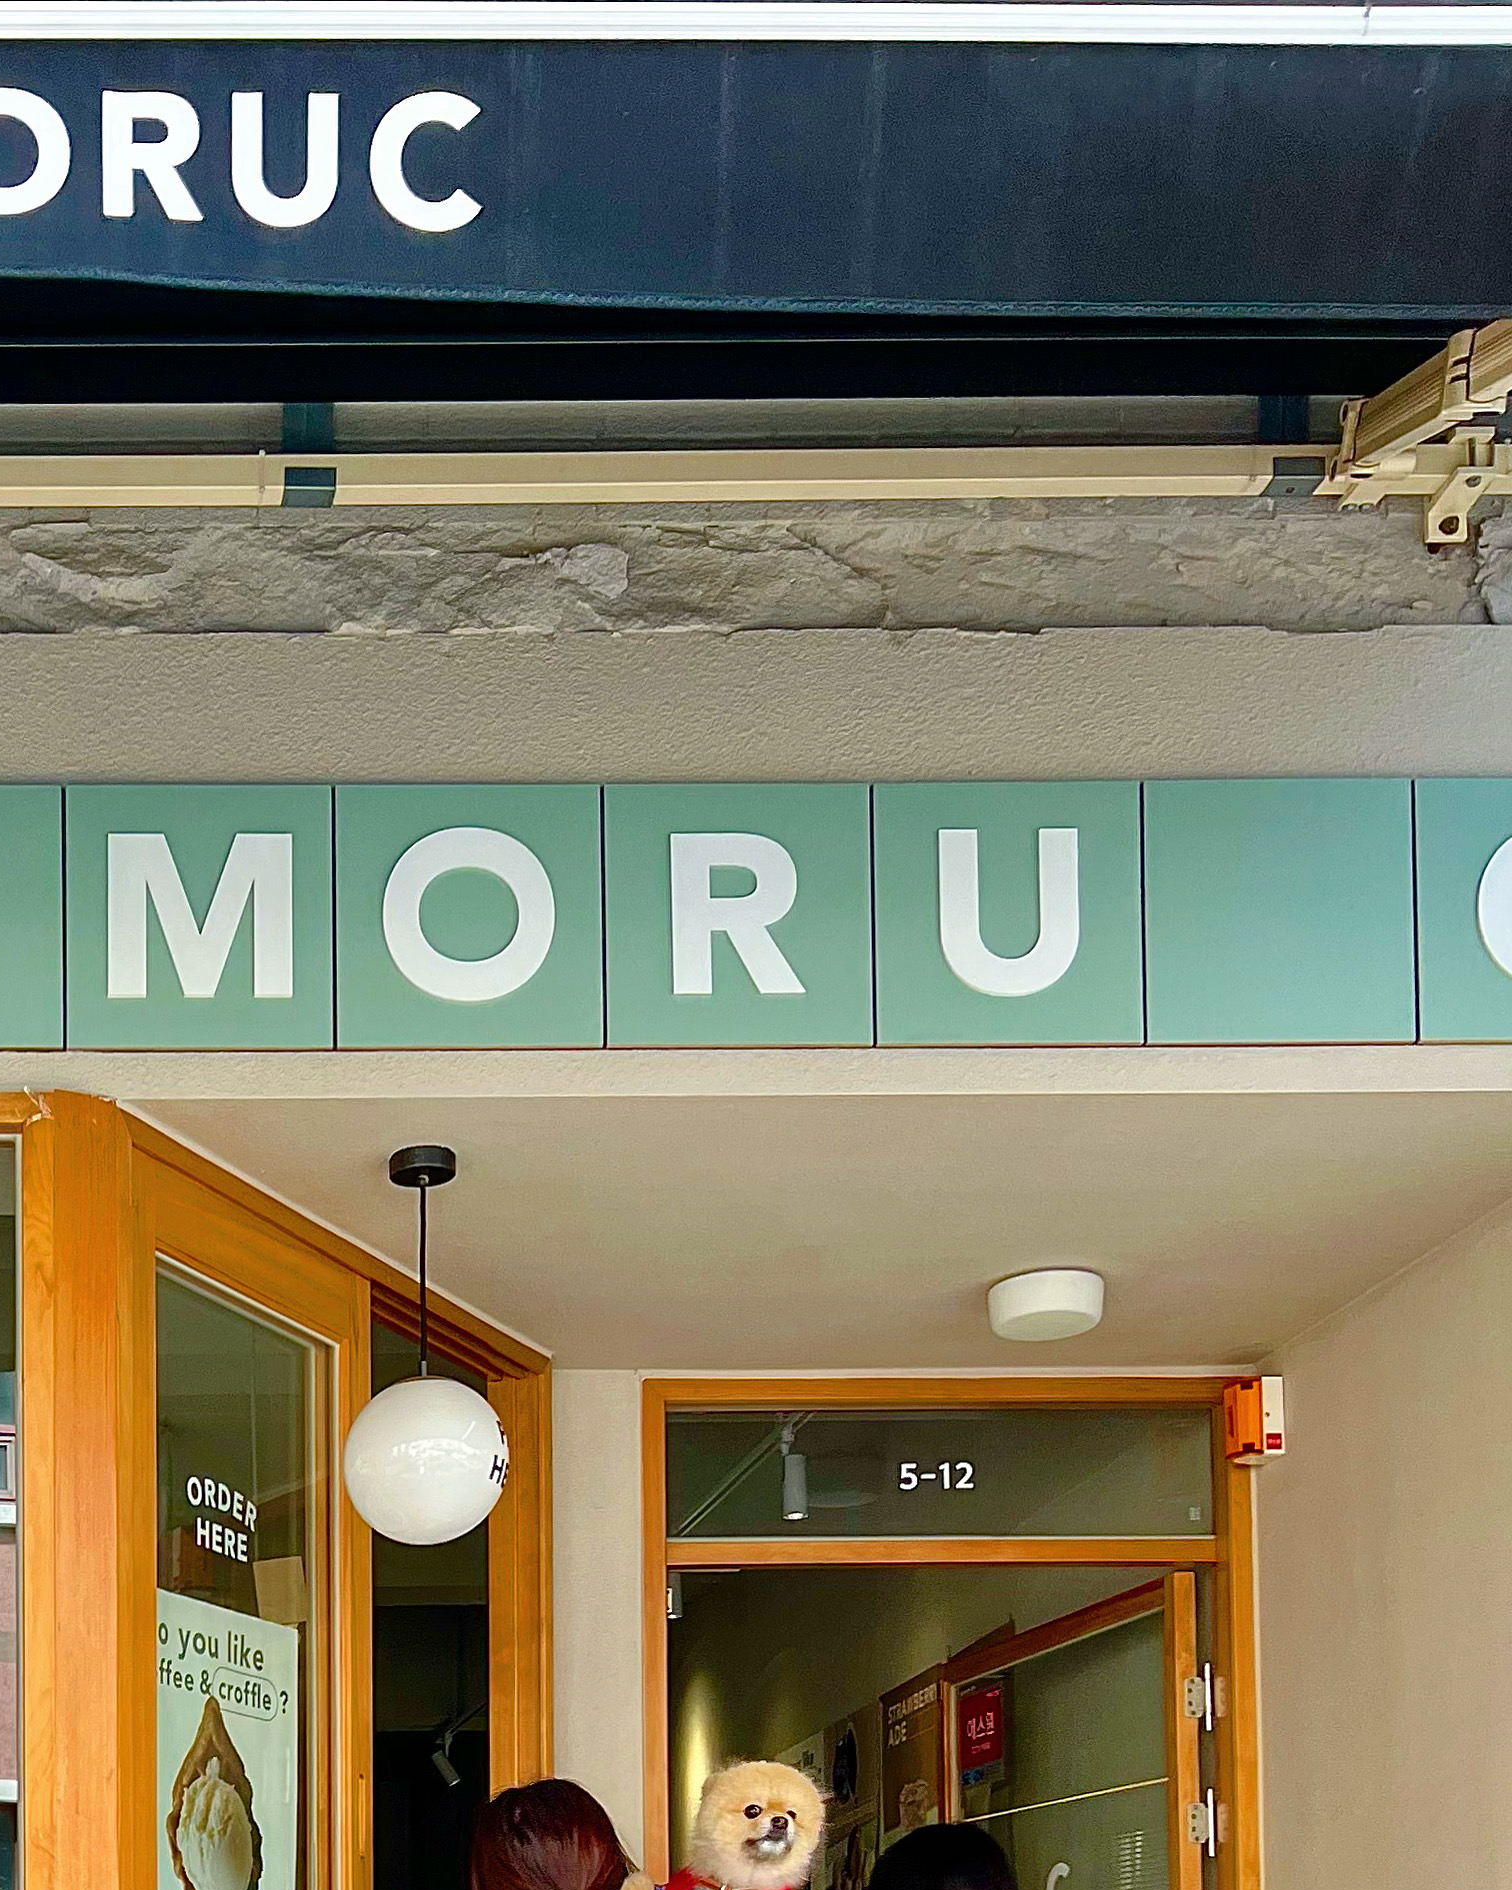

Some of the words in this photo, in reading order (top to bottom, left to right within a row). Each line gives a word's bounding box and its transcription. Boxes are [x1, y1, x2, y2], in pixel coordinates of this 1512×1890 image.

[899, 1461, 975, 1490] 5-12
[186, 1476, 257, 1532] ORDER
[196, 1517, 248, 1563] HERE
[177, 1627, 219, 1660] you
[227, 1630, 264, 1672] like
[159, 1657, 194, 1691] ffee
[200, 1669, 212, 1696] &
[218, 1680, 272, 1712] croffle
